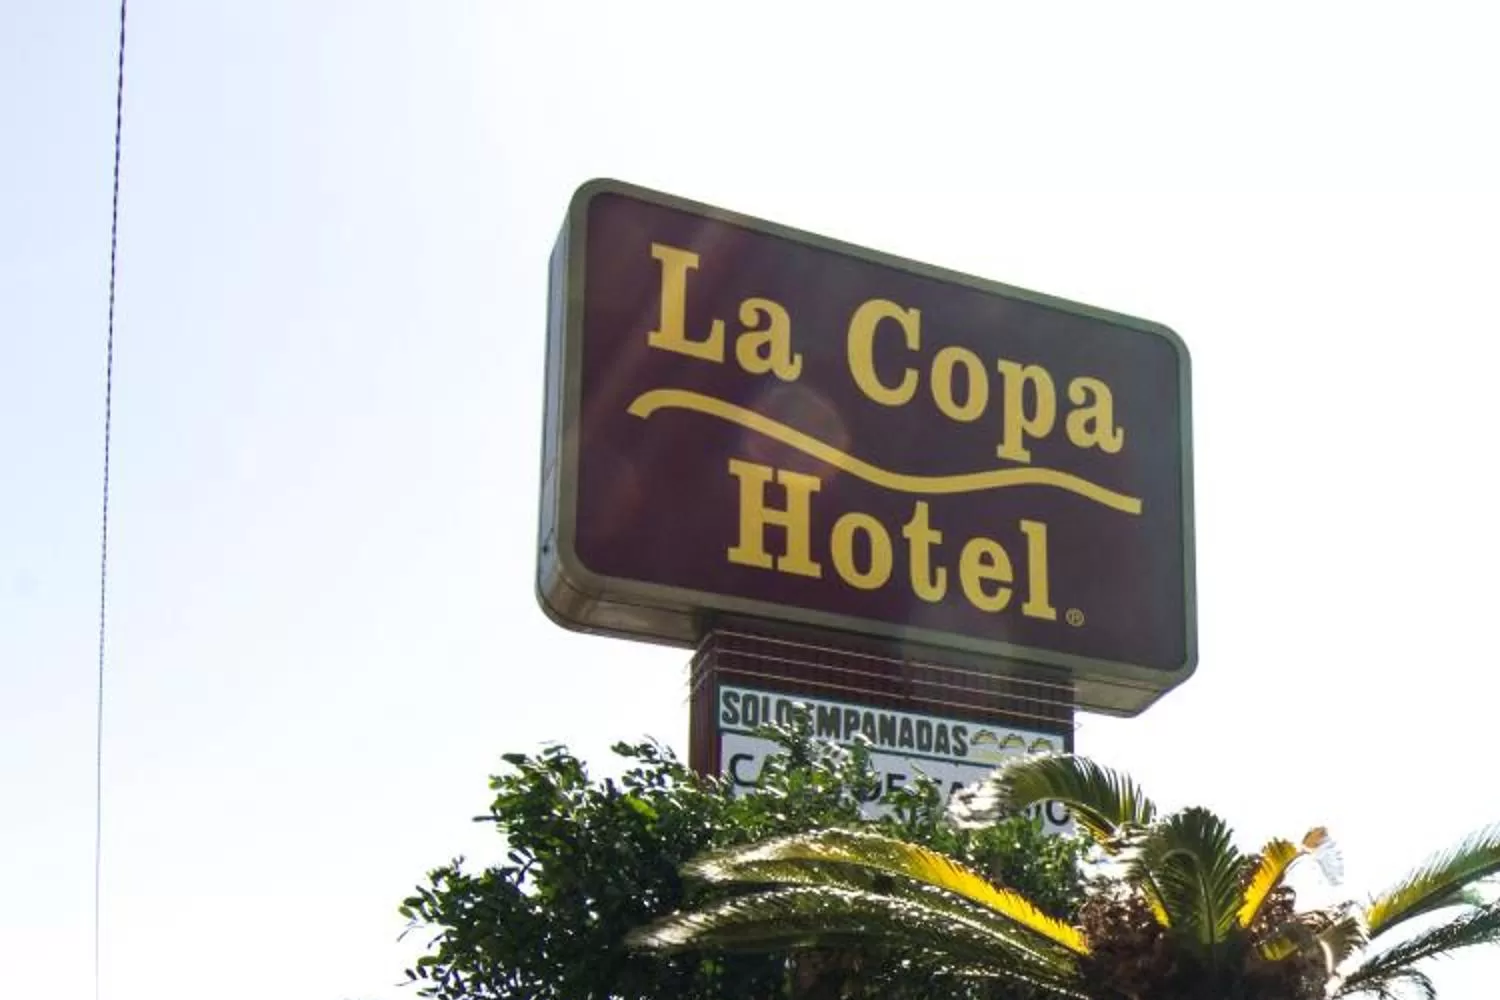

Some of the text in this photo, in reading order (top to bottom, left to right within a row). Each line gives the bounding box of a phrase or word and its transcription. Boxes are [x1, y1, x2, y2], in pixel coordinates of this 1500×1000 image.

[647, 242, 1124, 463] La Copa
[727, 459, 1056, 621] Hotel
